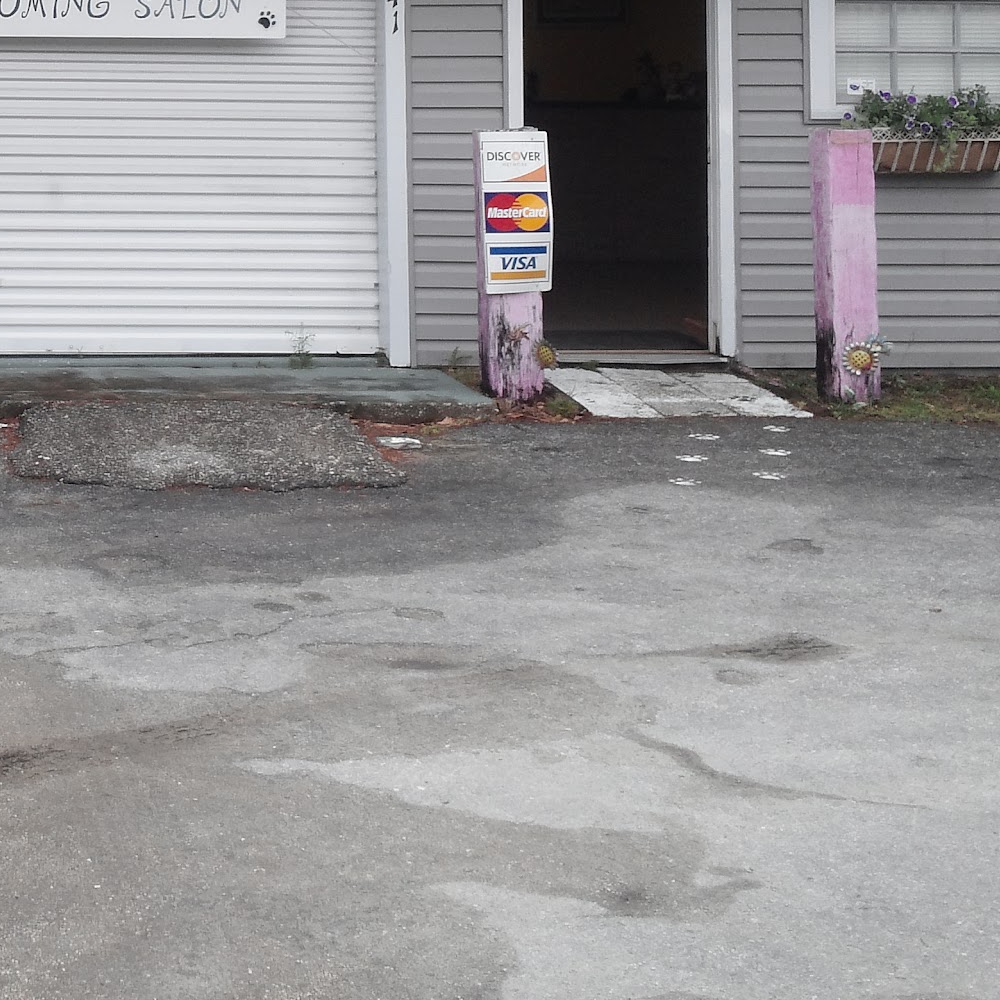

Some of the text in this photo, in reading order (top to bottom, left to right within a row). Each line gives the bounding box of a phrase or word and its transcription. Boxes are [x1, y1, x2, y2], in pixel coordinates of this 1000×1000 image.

[486, 151, 541, 161] DISCOVER
[487, 205, 548, 219] MasterCard
[501, 256, 537, 270] VISA
